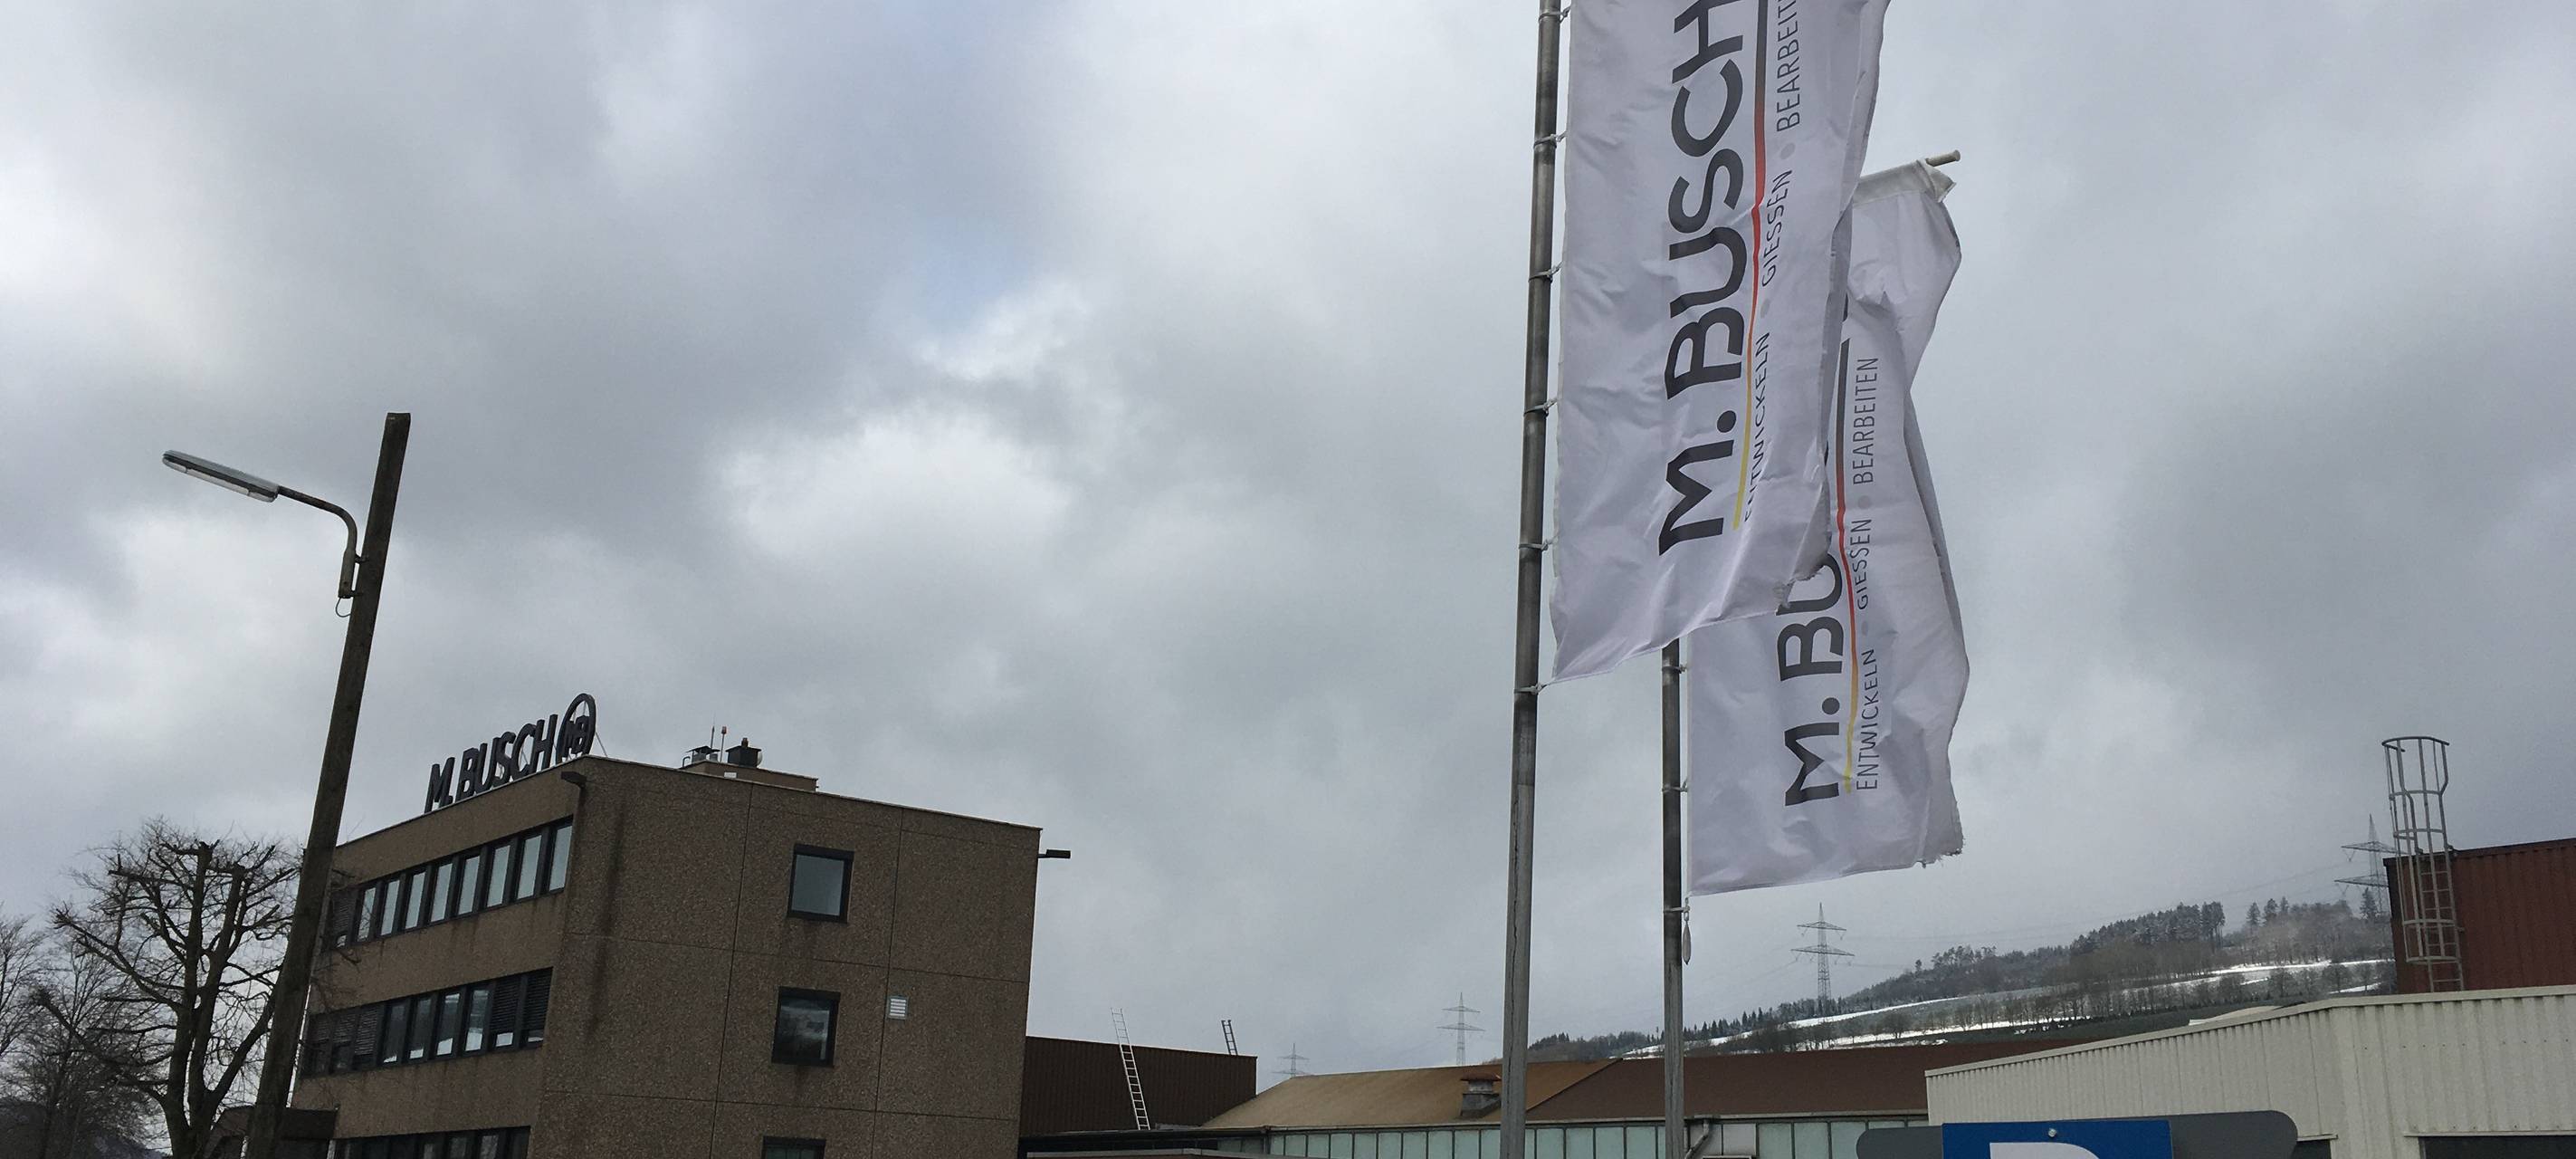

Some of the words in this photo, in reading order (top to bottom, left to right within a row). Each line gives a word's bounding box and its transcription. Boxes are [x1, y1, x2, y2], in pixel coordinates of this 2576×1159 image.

[1776, 0, 1800, 131] BEARBEIT
[1665, 0, 1748, 399] BUSCH
[1761, 170, 1793, 286] GIESSEN
[1658, 410, 1736, 556] M.
[1853, 358, 1879, 484] BEARBEITEN
[1776, 553, 1844, 681] BU
[1850, 519, 1872, 609] GIESSEN
[425, 757, 453, 813] M.
[455, 714, 558, 801] BUSCH
[1784, 696, 1840, 806] M.
[1856, 649, 1878, 790] ENTWICKELN
